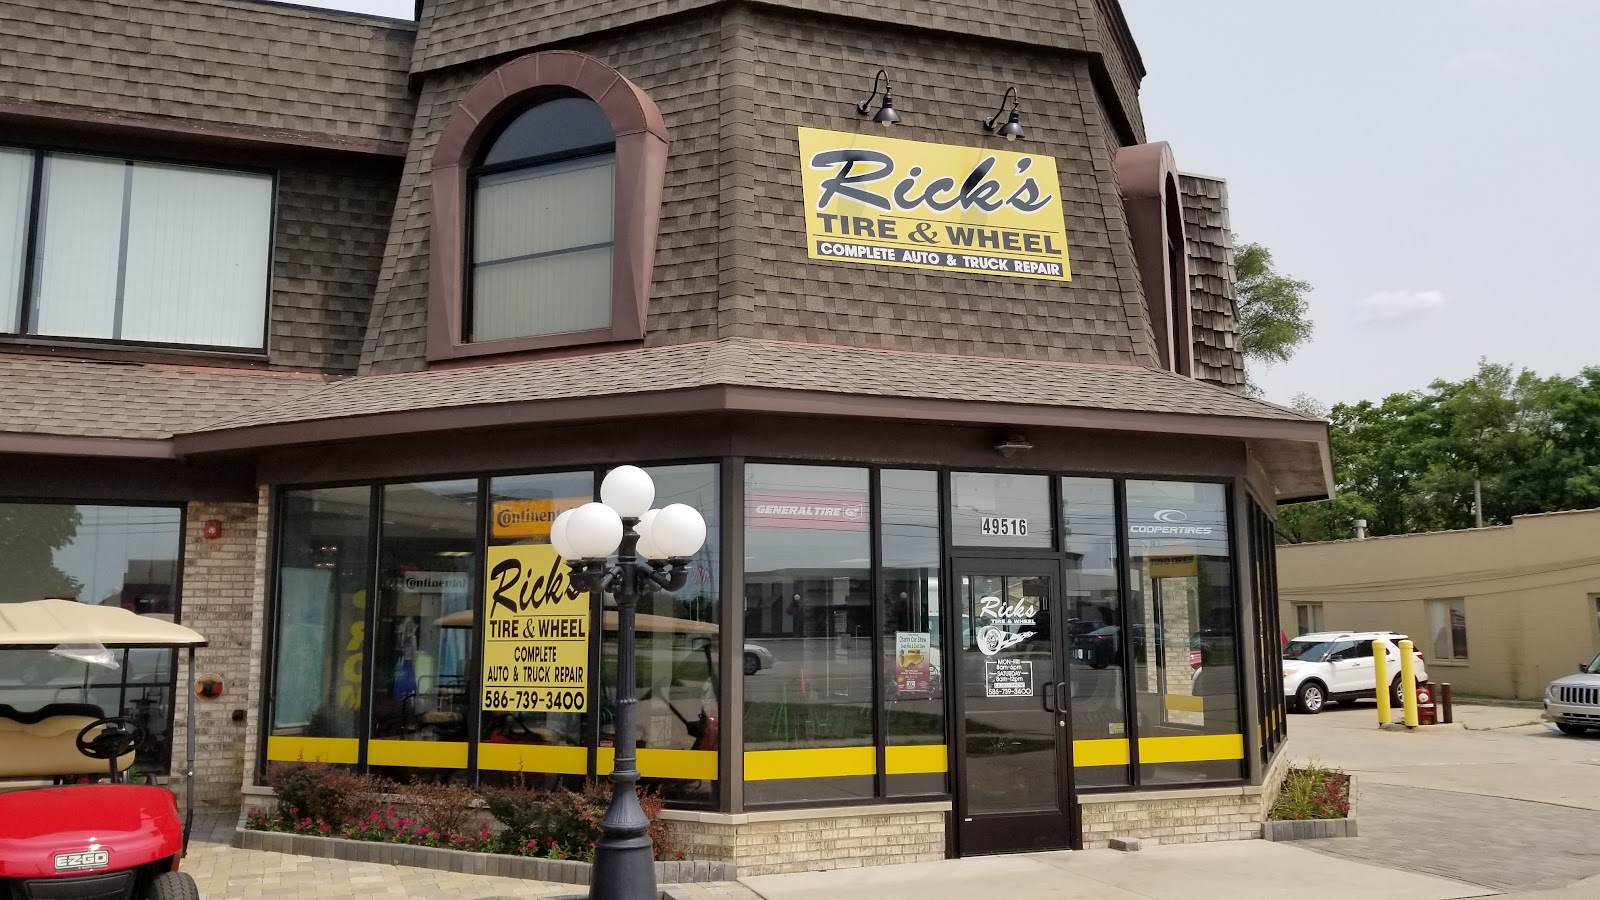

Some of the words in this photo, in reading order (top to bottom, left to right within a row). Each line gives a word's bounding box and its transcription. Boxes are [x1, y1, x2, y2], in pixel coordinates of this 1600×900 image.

[809, 147, 1054, 215] Rick's
[816, 212, 898, 240] TIRE
[908, 222, 941, 245] &
[945, 225, 1062, 255] WHEEL
[820, 242, 896, 262] COMPLETE
[902, 249, 940, 266] AUTO
[946, 254, 957, 267] &
[963, 255, 1009, 272] TRUCK
[1014, 260, 1060, 276] REPAIR
[755, 505, 813, 517] GENERAL
[814, 506, 842, 517] TIRE
[983, 517, 1027, 536] 49516
[489, 619, 520, 638] TIRE
[522, 618, 536, 639] &
[538, 618, 586, 638] WHEEL
[514, 646, 557, 663] COMPLETE
[487, 665, 509, 682] AUTO
[513, 665, 519, 682] &
[523, 665, 551, 683] TRUCK
[554, 666, 584, 683] REPAIR
[485, 690, 585, 710] 586-739-3400
